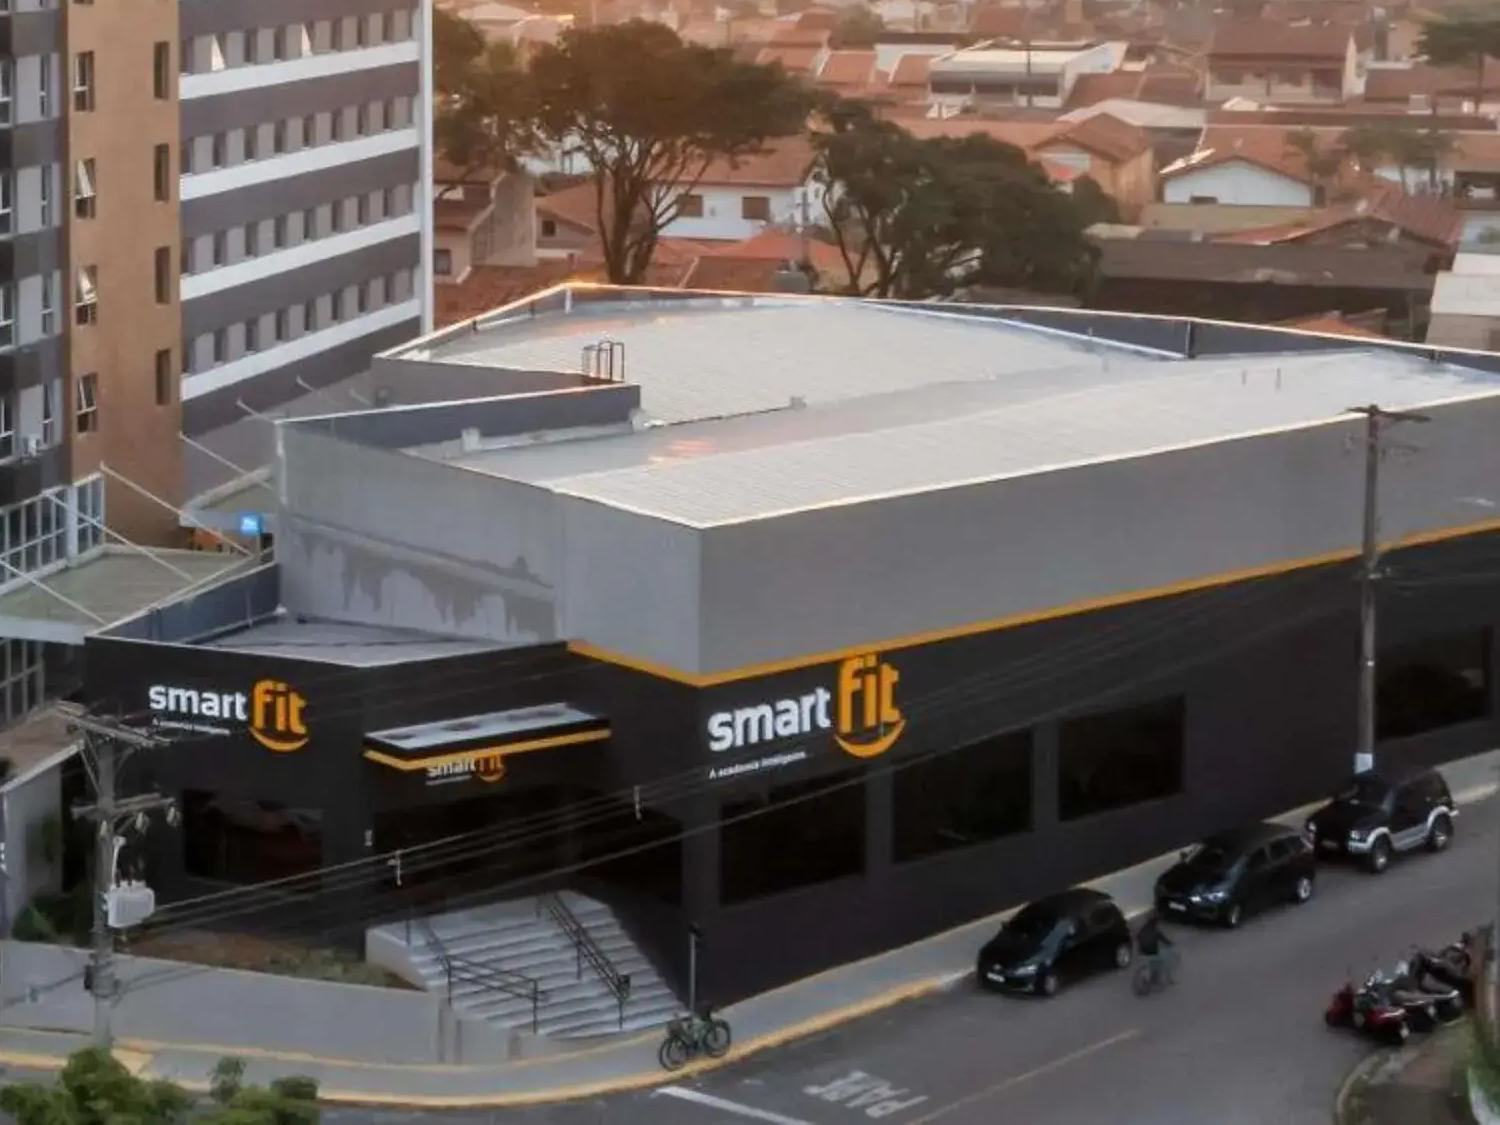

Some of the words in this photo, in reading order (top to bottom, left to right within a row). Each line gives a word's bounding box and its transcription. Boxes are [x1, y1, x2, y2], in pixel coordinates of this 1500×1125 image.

[148, 684, 248, 721] smart
[253, 679, 308, 735] fit
[707, 686, 832, 752] smart
[838, 653, 901, 735] fit
